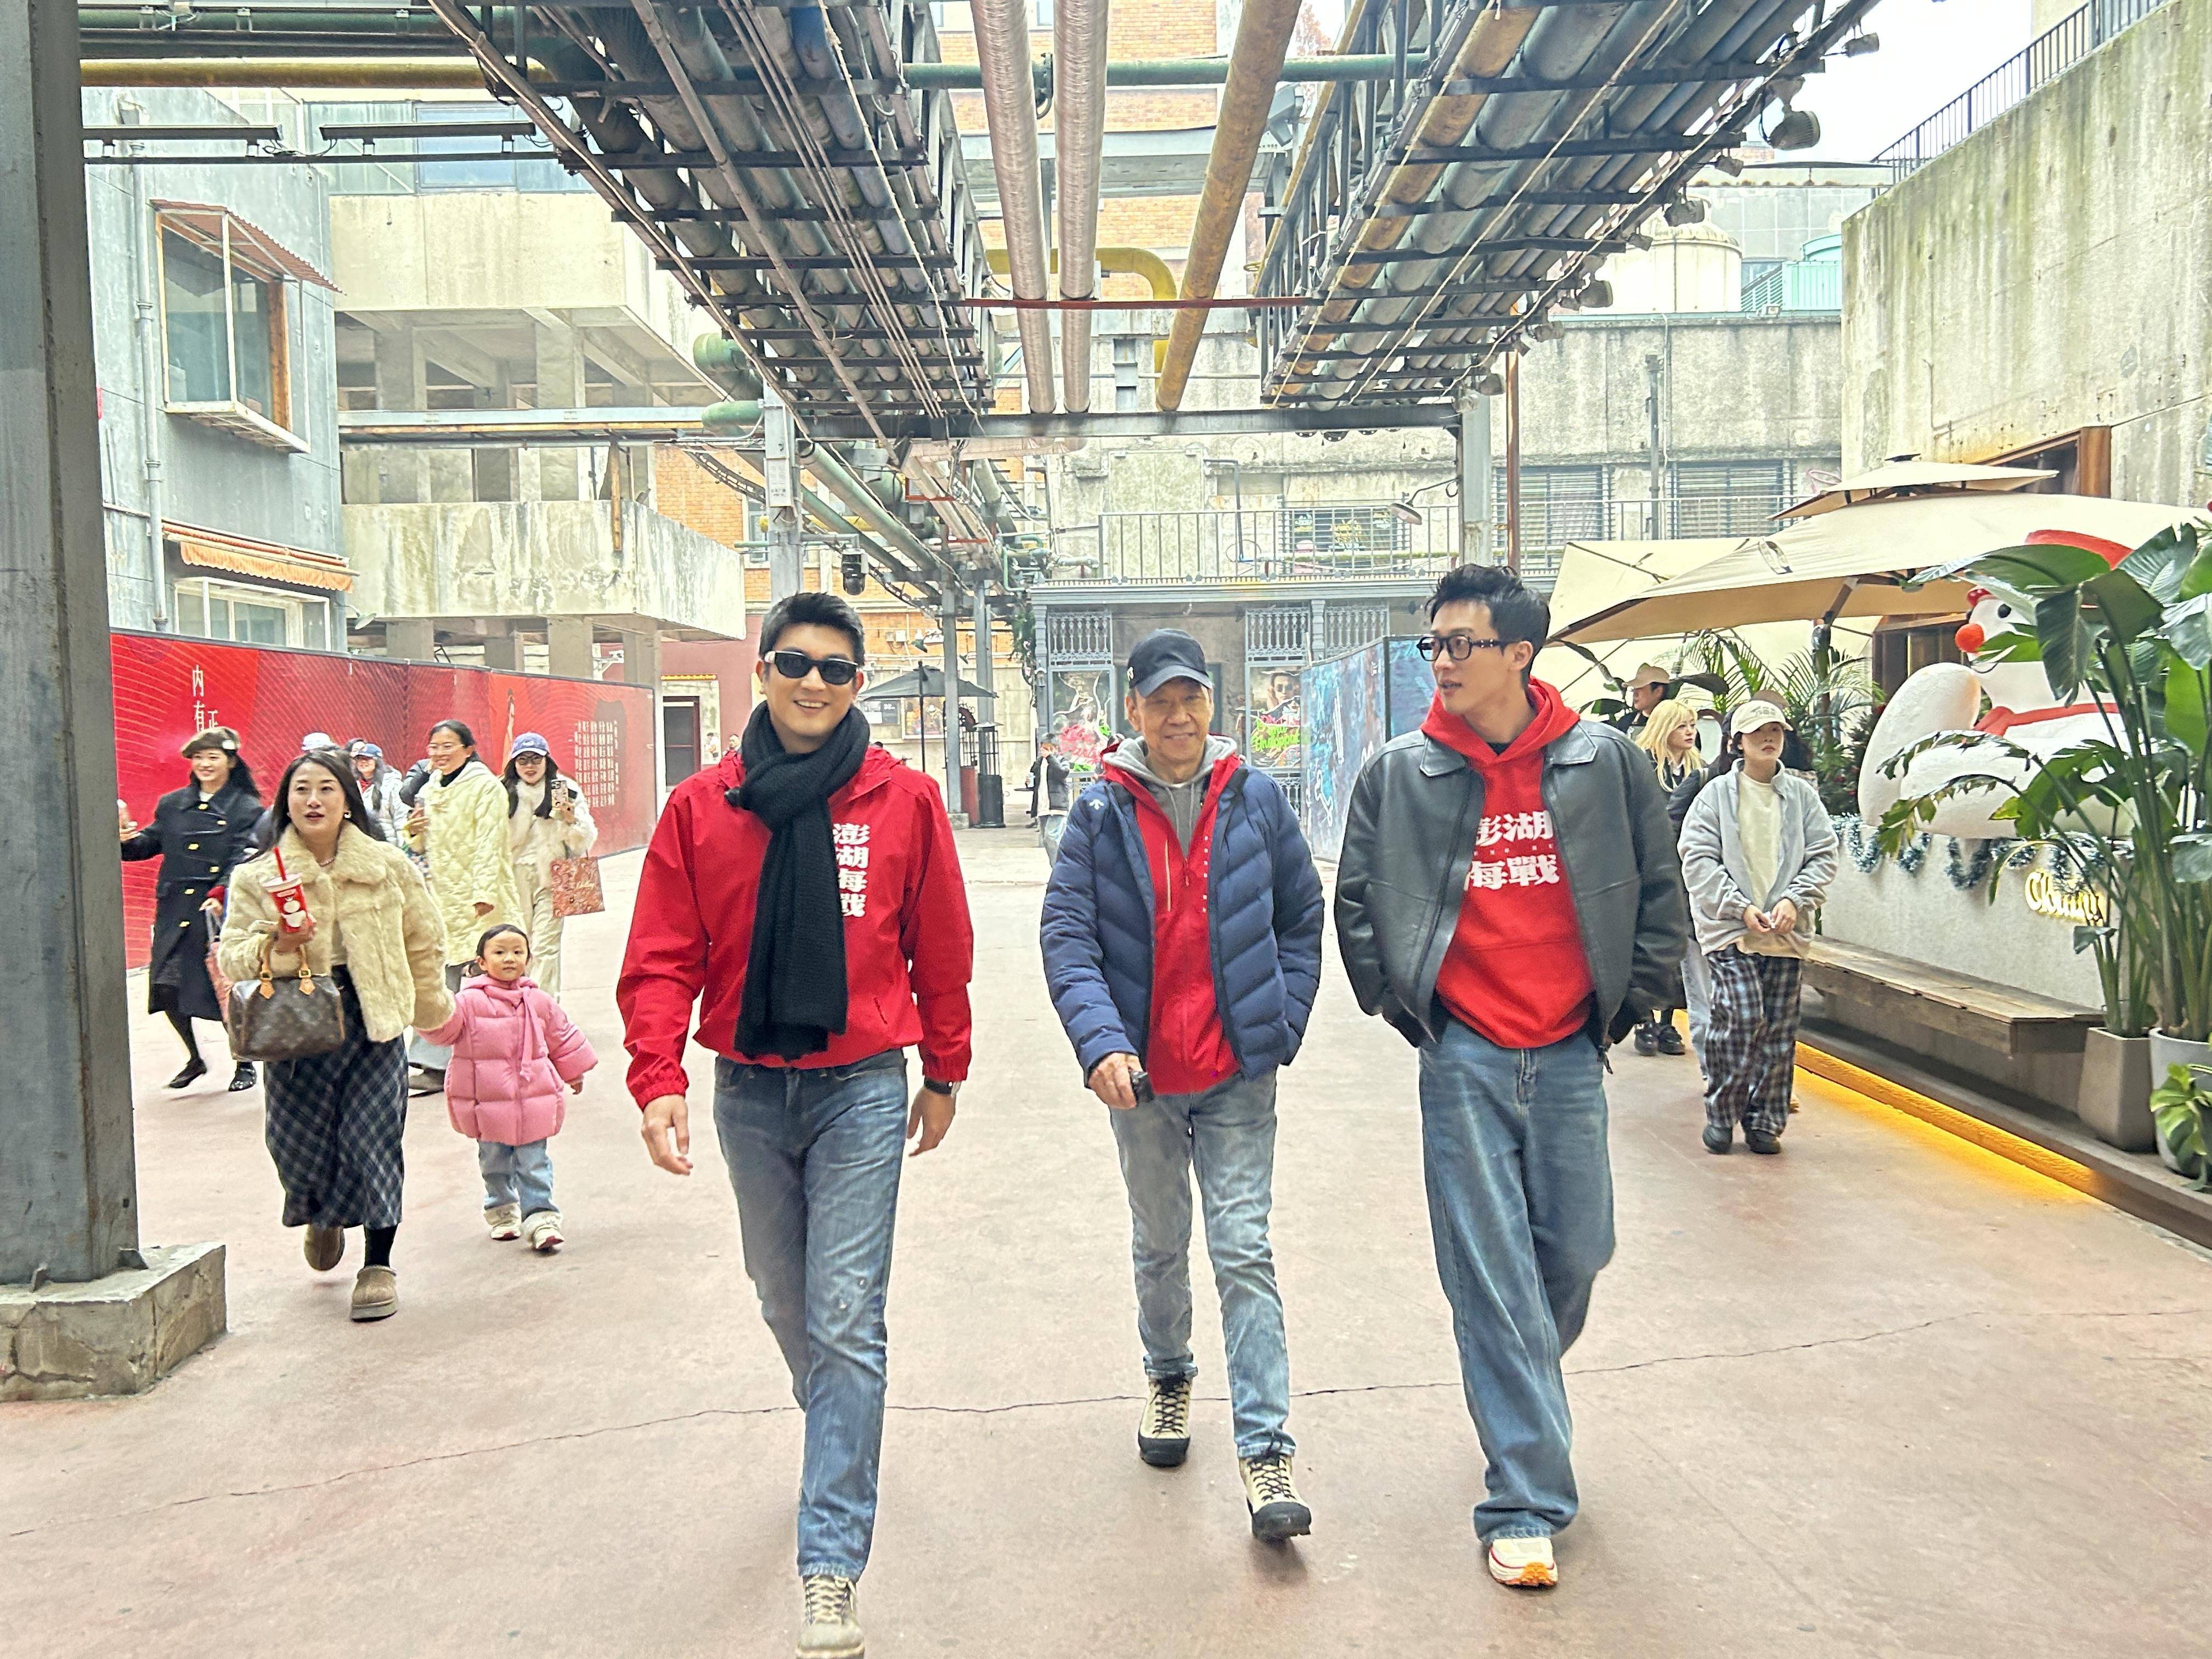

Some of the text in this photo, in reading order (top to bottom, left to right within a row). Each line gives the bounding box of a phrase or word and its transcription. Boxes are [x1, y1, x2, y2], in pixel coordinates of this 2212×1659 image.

[192, 664, 205, 732] 内有
[1476, 810, 1554, 847] 澎湖
[1463, 854, 1560, 891] 海戰
